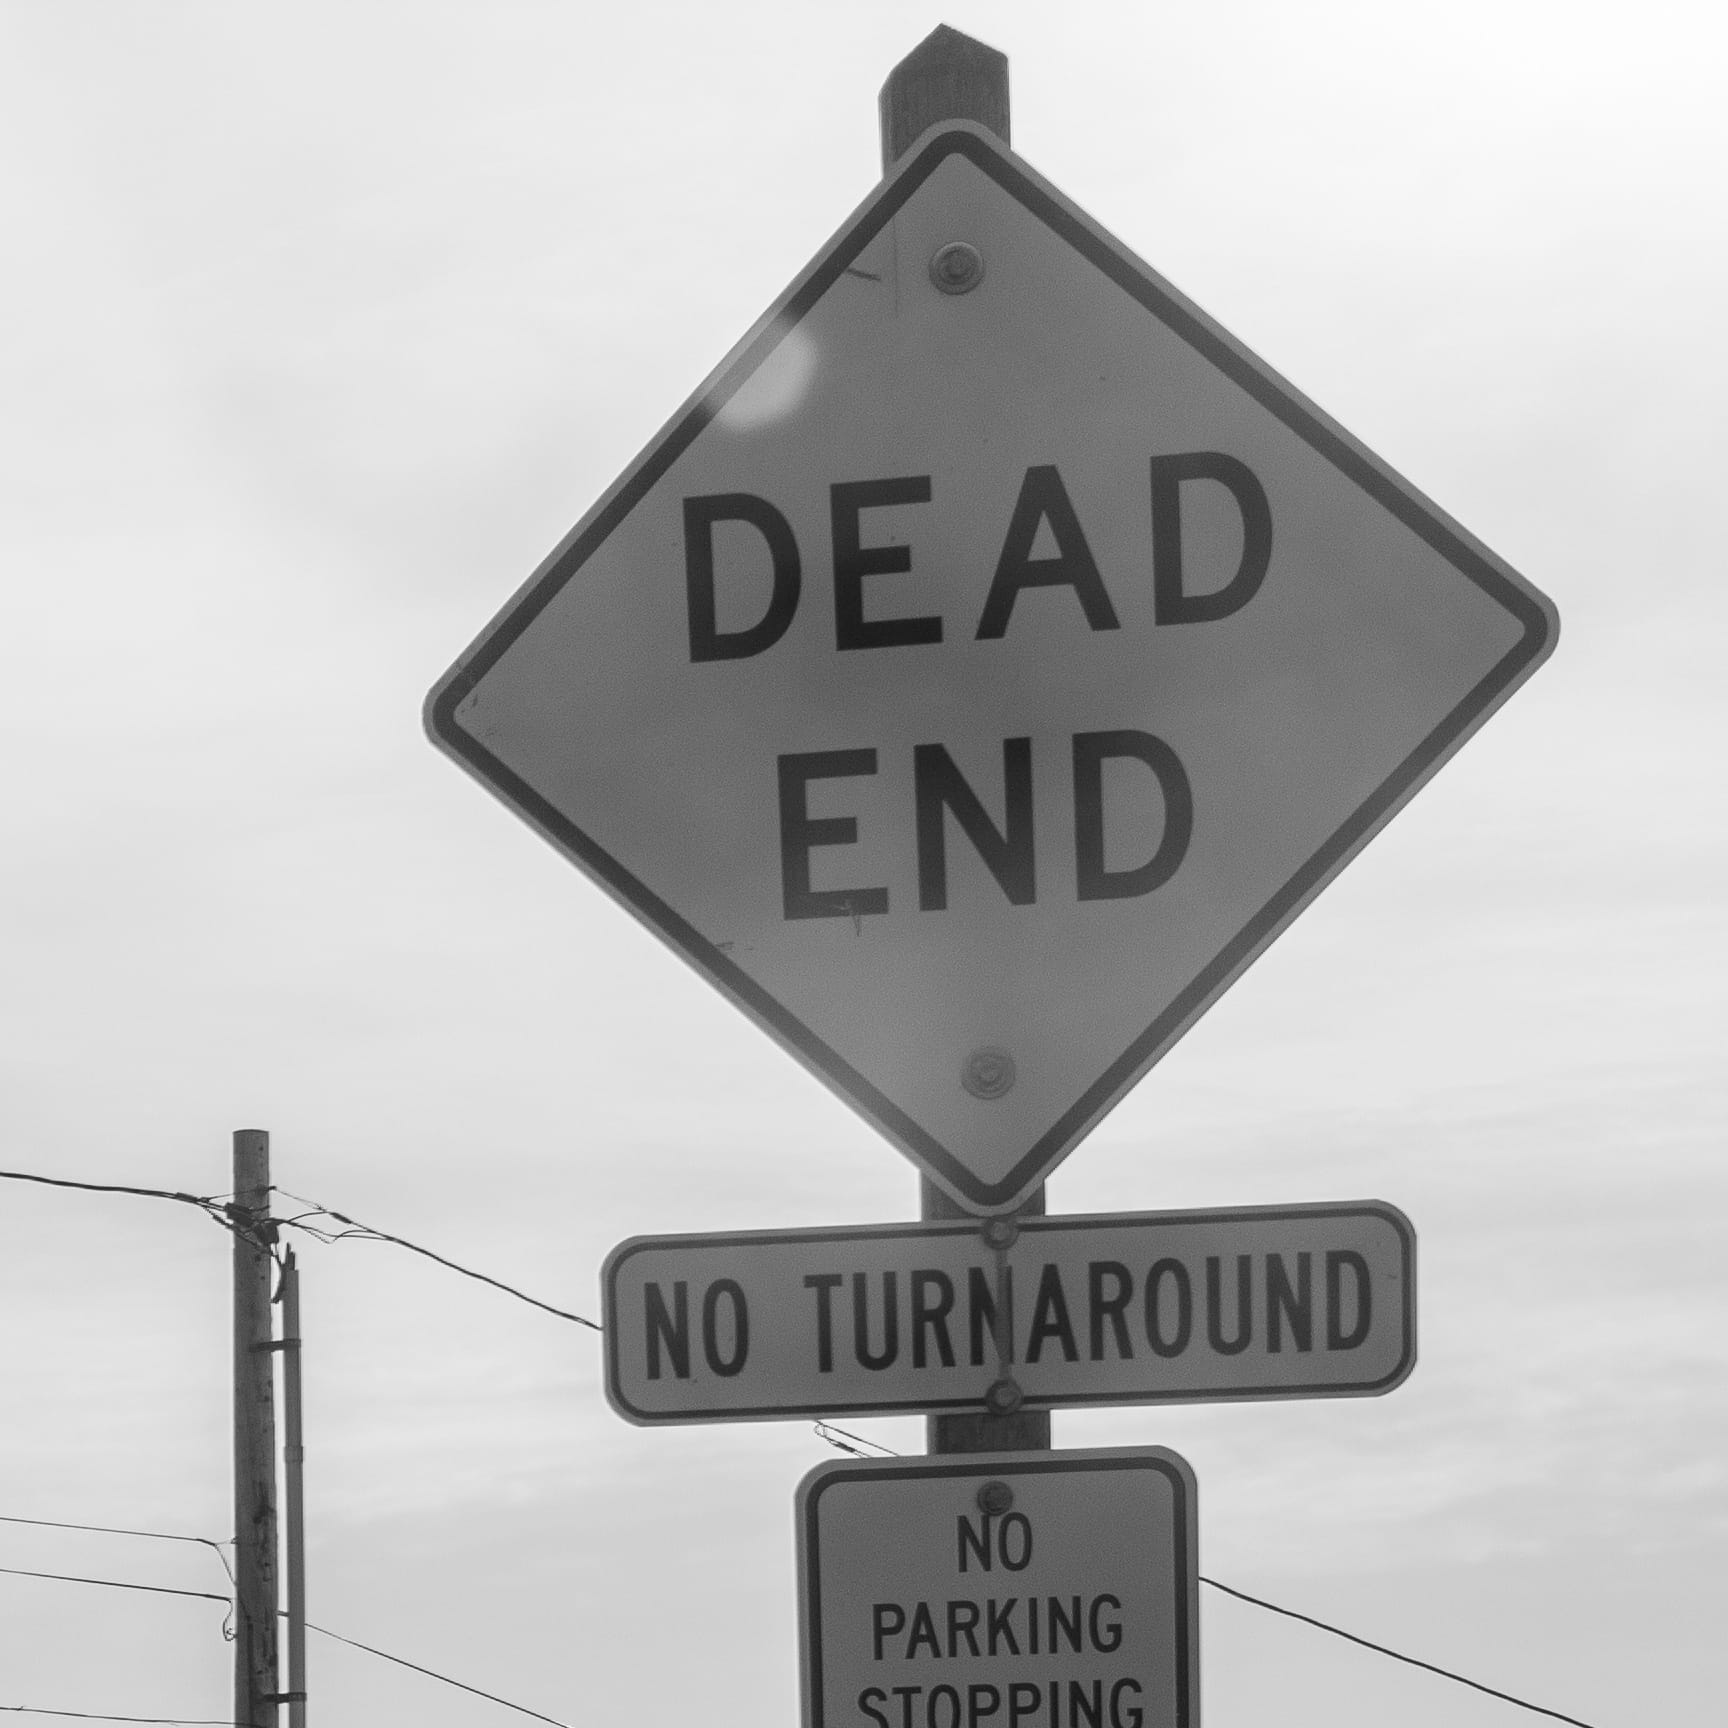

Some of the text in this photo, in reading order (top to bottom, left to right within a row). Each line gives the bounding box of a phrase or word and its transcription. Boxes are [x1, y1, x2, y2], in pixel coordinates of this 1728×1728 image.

[681, 450, 1275, 665] DEAD
[776, 728, 1195, 922] END
[643, 1248, 1373, 1381] NO TURNAROUND
[956, 1511, 1033, 1573] NO
[872, 1593, 1124, 1661] PARKING
